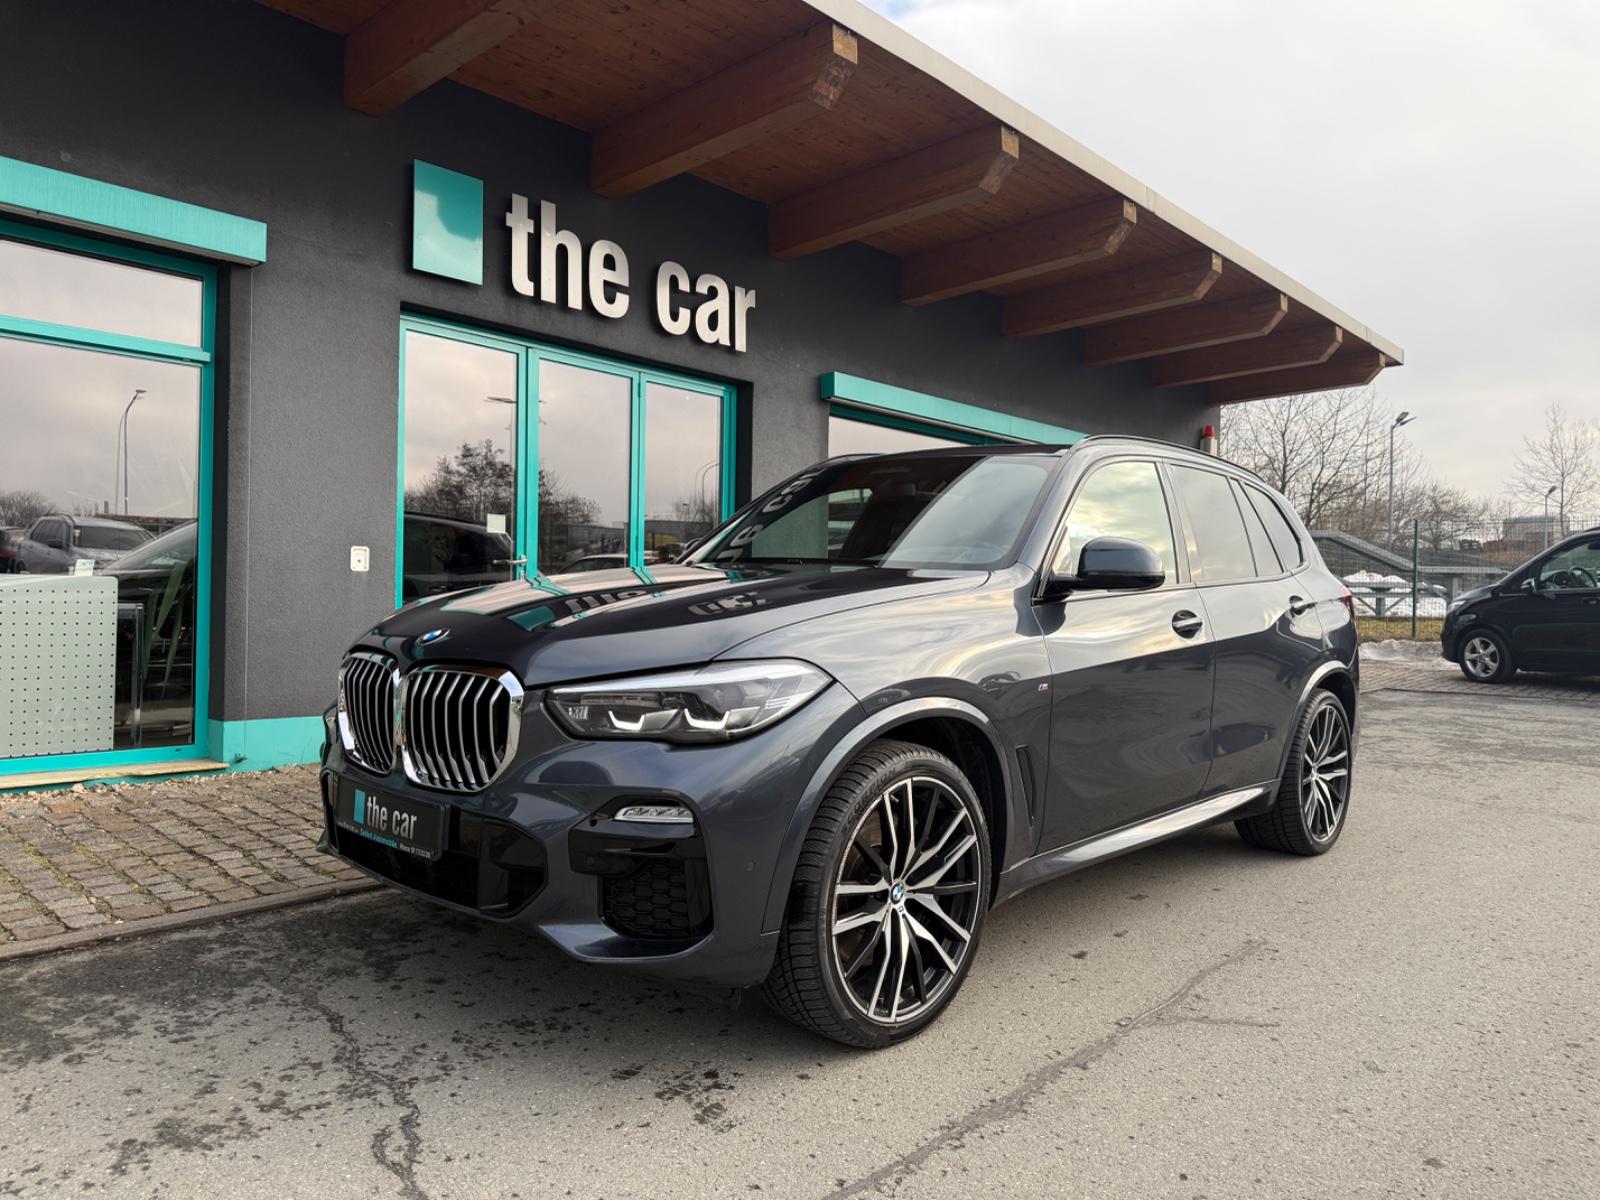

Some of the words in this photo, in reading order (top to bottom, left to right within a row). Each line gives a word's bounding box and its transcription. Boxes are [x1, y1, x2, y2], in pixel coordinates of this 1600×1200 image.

[505, 193, 630, 319] the
[656, 261, 756, 352] car
[367, 796, 388, 831] the
[392, 811, 417, 839] car
